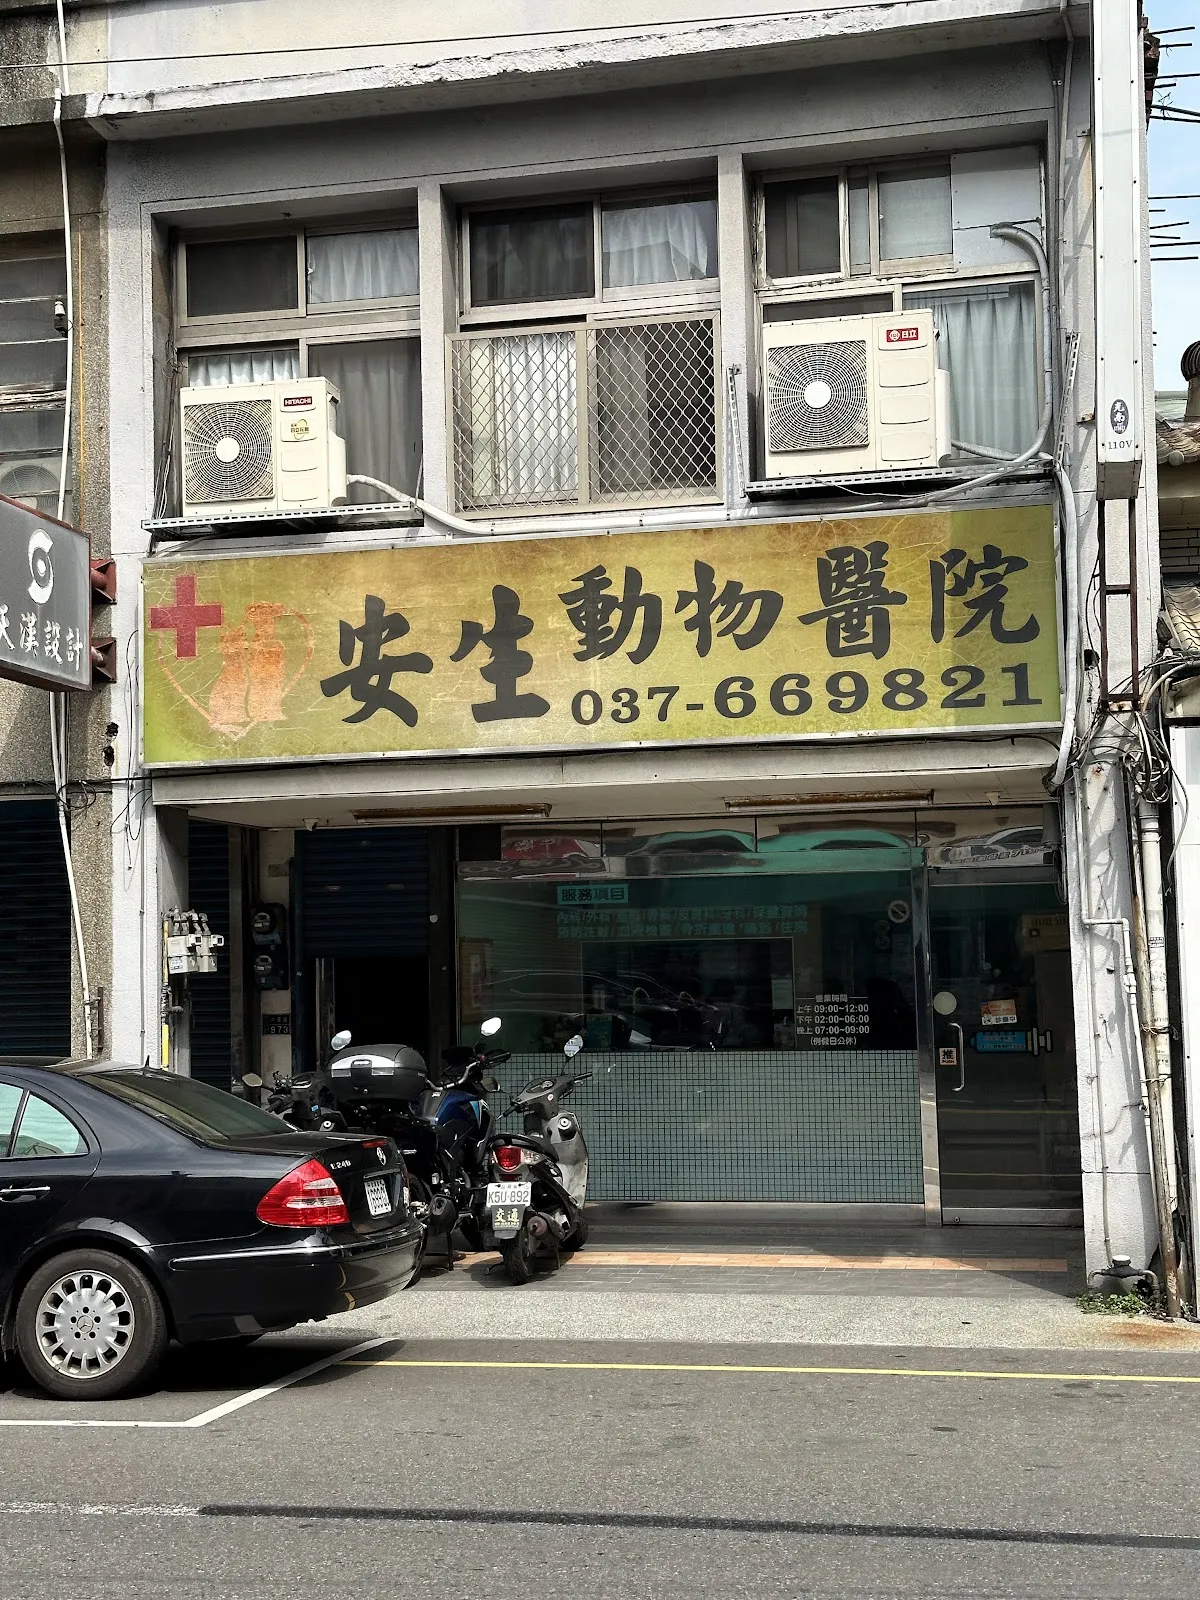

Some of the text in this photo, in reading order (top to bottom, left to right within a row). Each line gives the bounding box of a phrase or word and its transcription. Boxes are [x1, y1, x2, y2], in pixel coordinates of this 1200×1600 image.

[901, 329, 917, 339] 日立
[284, 398, 312, 406] HITACHI
[1108, 440, 1133, 450] 110V
[320, 541, 1040, 727] 安生動物醫院
[570, 662, 1043, 725] 037-669821
[561, 887, 625, 902] 服務項目
[796, 1004, 869, 1014] 上午 09:00~12:00
[796, 1015, 870, 1024] 下午 02:00~06:00
[270, 1025, 289, 1034] 973
[796, 1025, 870, 1035] 晚上 07:00~09:00
[942, 1049, 954, 1060] 推
[494, 1207, 520, 1223] 交通
